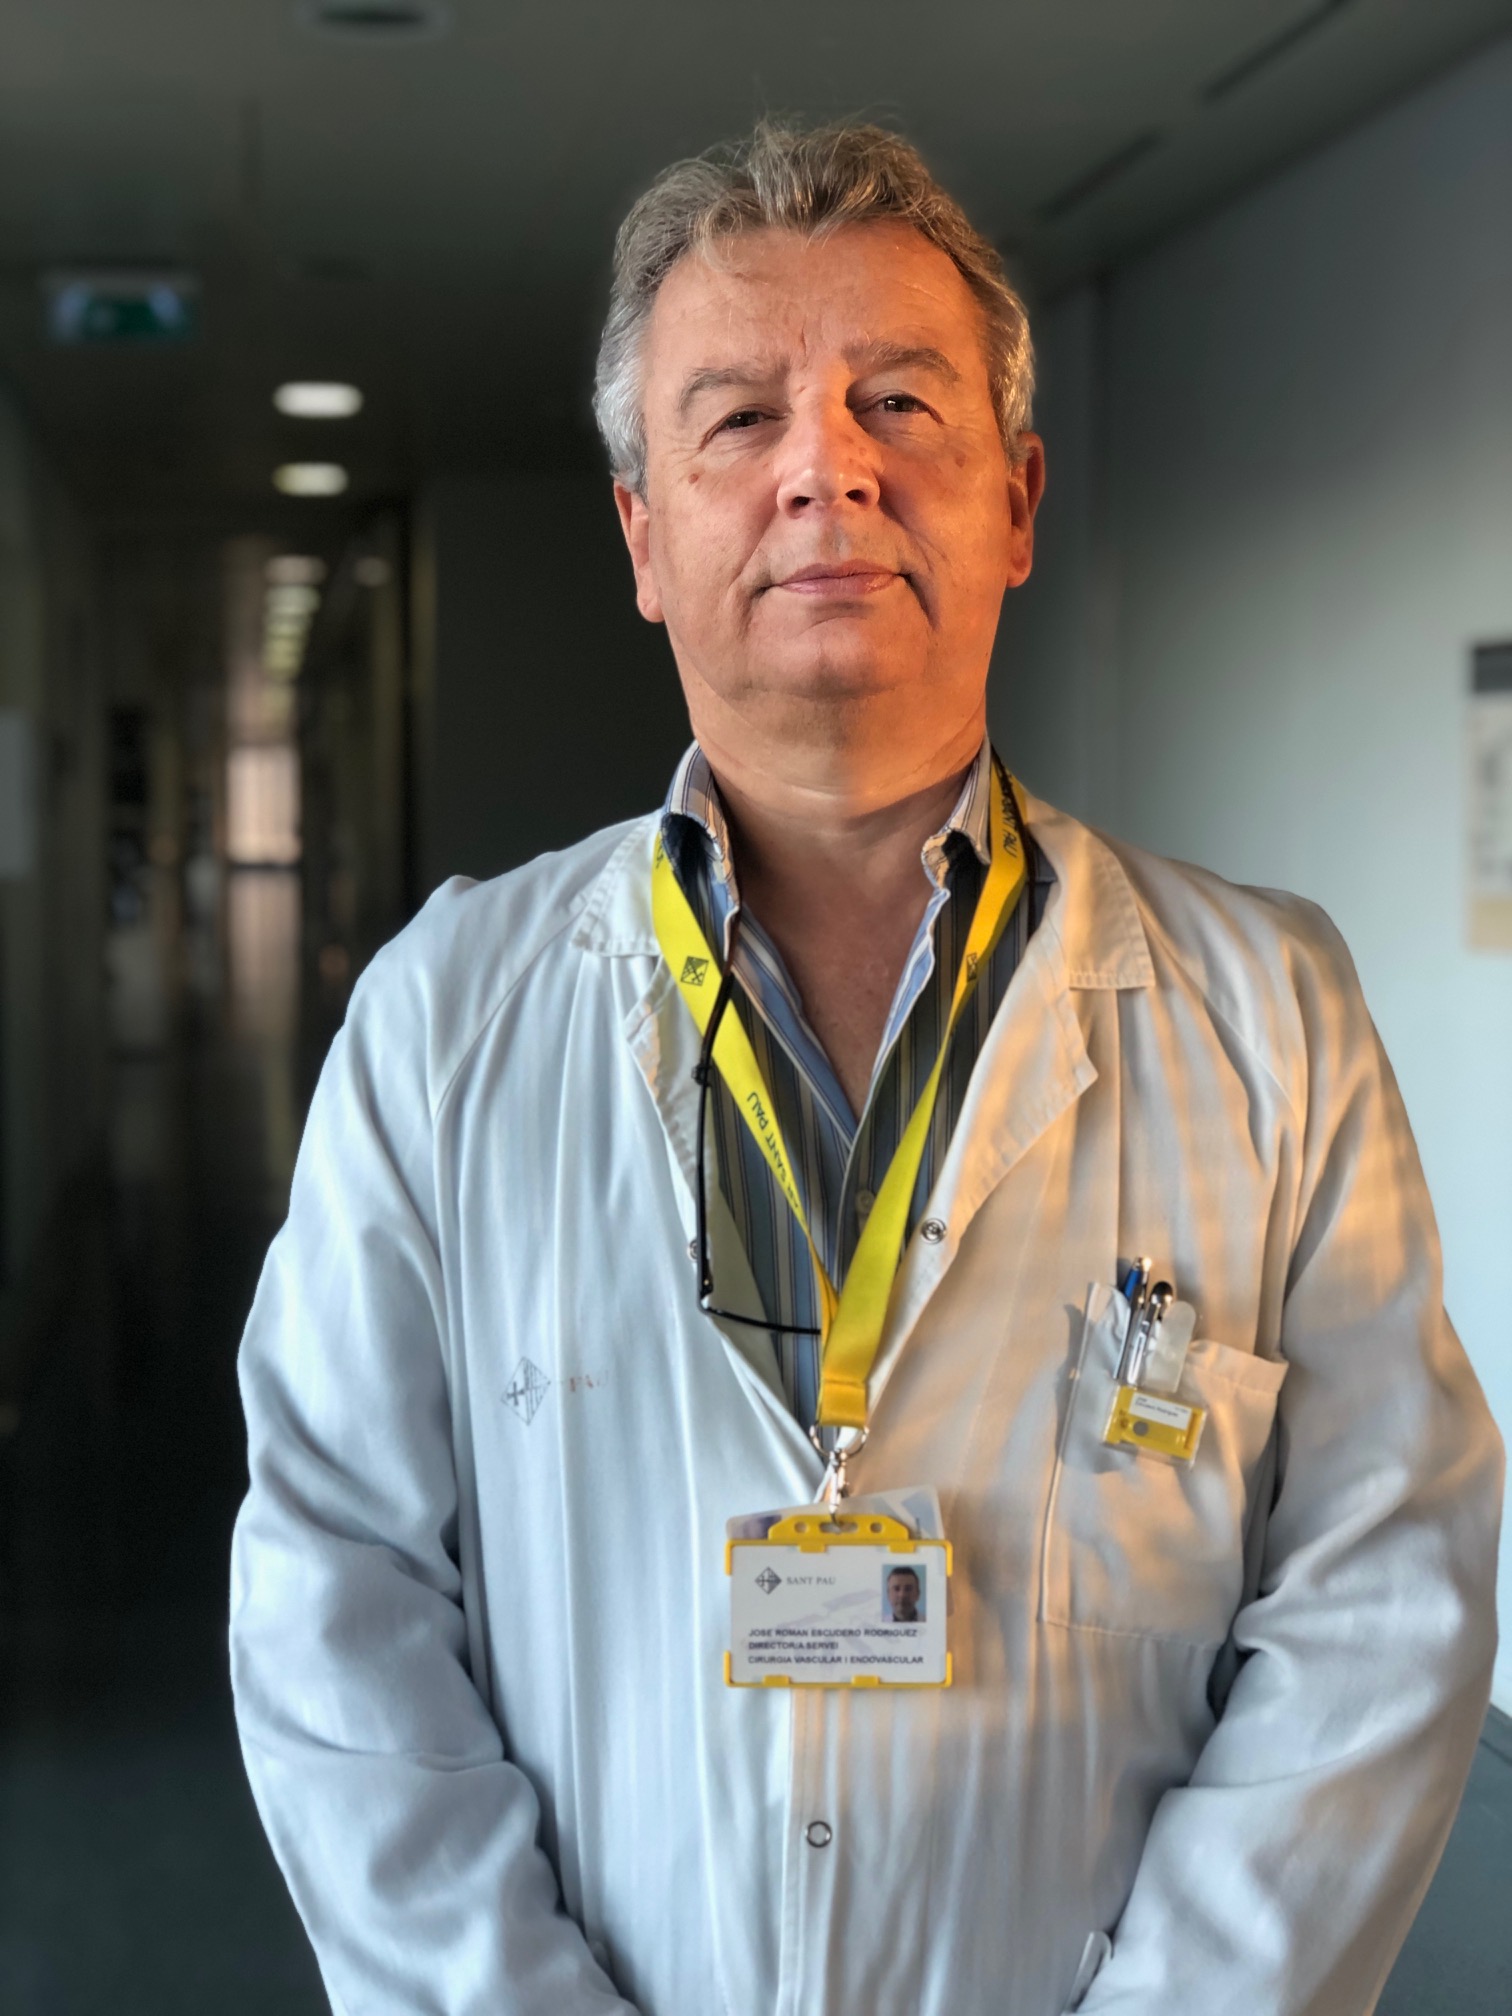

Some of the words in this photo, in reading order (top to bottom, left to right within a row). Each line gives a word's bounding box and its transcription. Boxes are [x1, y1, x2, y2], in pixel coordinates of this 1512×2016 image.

[747, 1091, 769, 1130] PAU
[786, 1576, 813, 1586] SANT
[816, 1576, 836, 1586] PAU
[749, 1629, 772, 1637] JOSE
[775, 1629, 808, 1637] ROMAN
[811, 1629, 861, 1637] ESCUDERO
[864, 1629, 918, 1637] RODRIGUEZ
[748, 1656, 792, 1664] CIRURGIA
[794, 1656, 842, 1664] VASCULAR
[850, 1656, 923, 1664] ENDOVASCULAR
